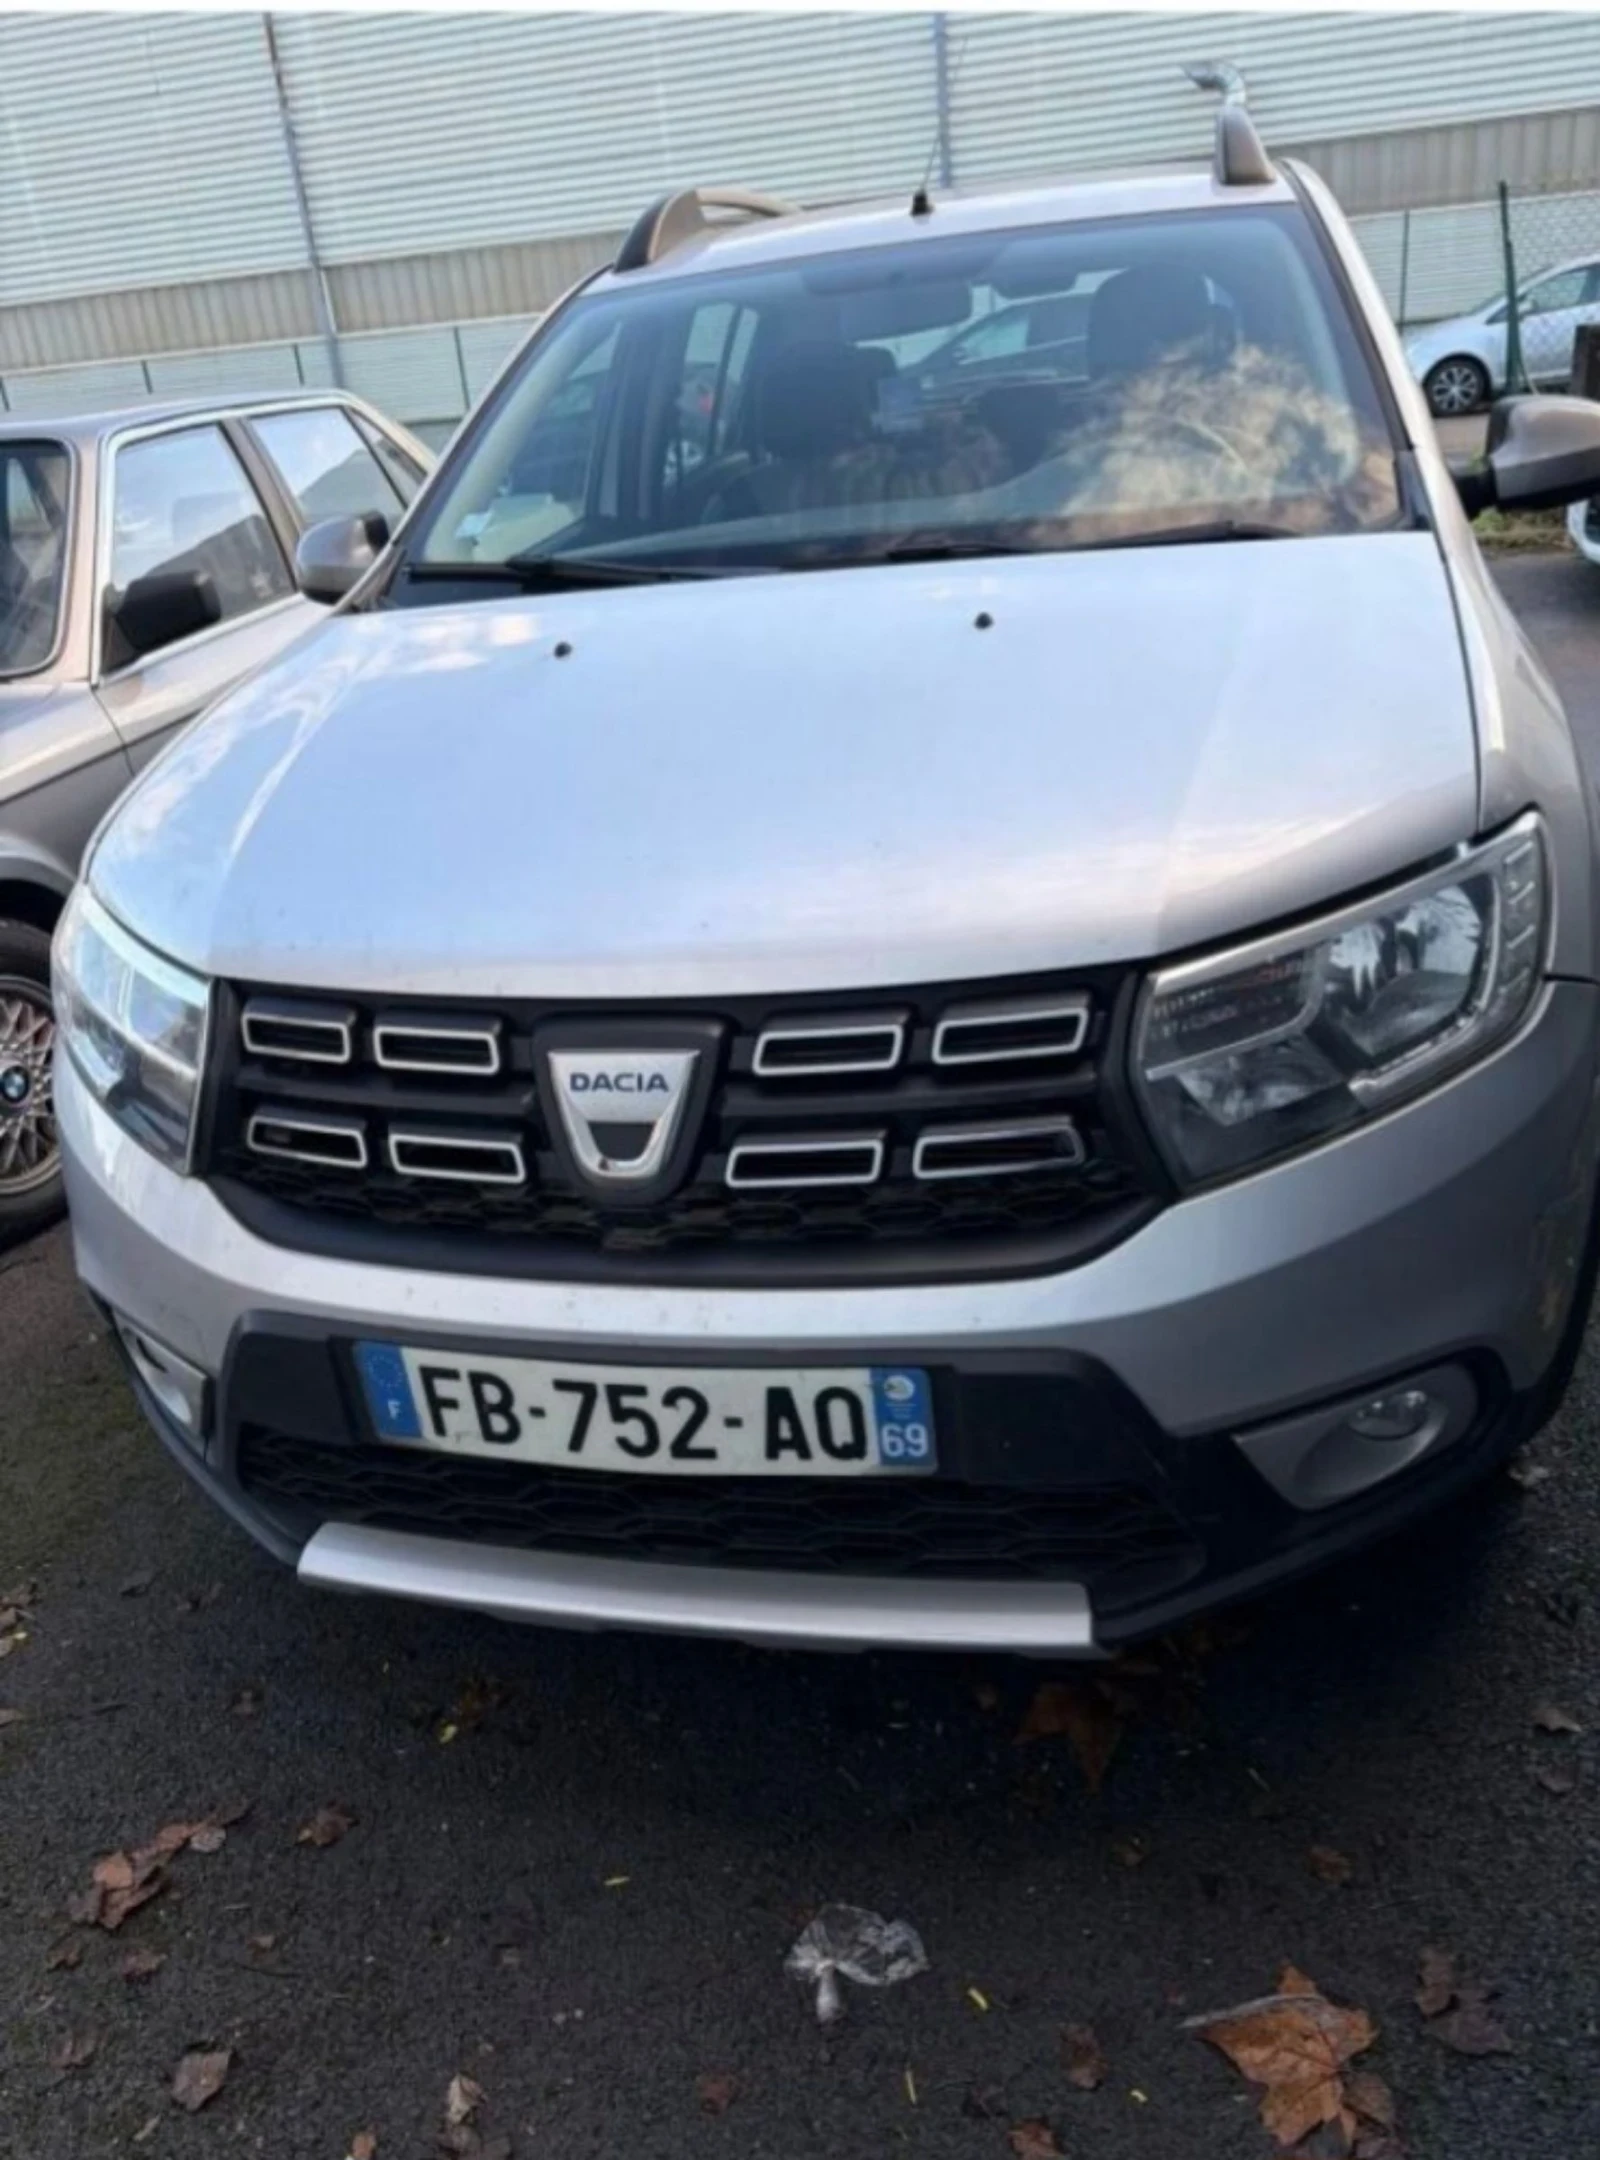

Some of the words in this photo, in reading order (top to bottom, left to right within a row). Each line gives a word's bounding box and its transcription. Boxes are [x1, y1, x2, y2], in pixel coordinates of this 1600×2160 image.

[569, 1072, 669, 1093] DACIA
[388, 1399, 400, 1420] F
[418, 1364, 868, 1462] FB-752-AQ
[882, 1422, 928, 1458] 69
